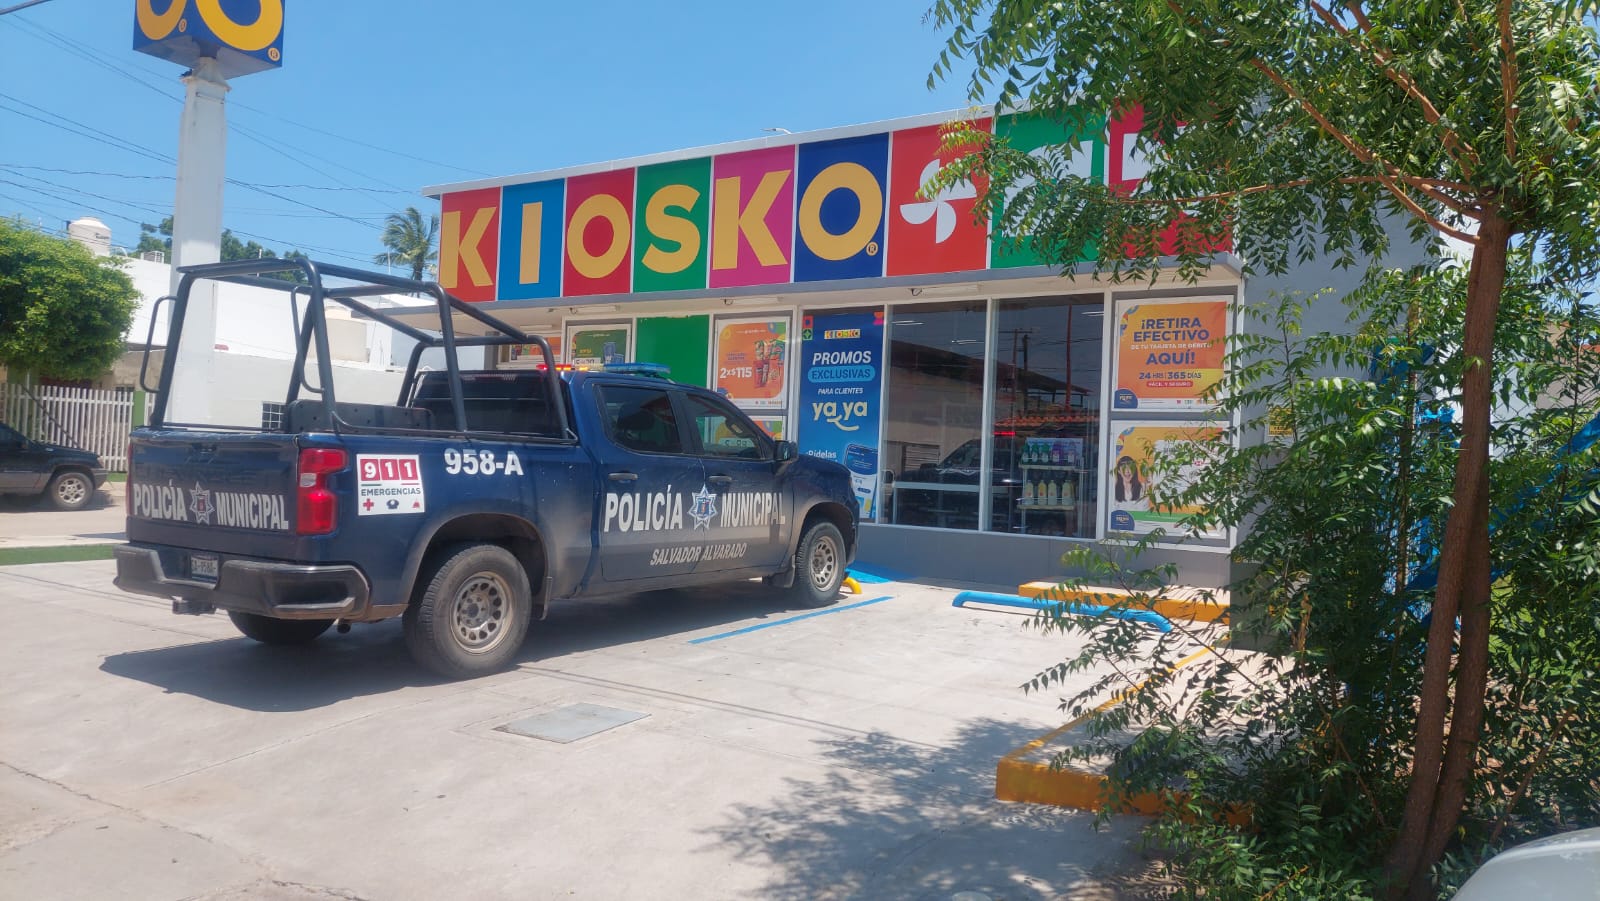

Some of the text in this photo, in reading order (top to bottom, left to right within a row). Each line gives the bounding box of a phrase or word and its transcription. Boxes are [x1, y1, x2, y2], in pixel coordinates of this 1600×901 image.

[438, 162, 882, 288] KIOSKO
[1141, 317, 1202, 330] ¡RETIRA
[1133, 329, 1210, 342] EFECTIVO
[812, 350, 872, 366] PROMOS
[1146, 348, 1196, 365] AQUÍ!
[811, 368, 871, 380] EXCLUSIVAS
[1167, 371, 1186, 379] 365
[834, 387, 864, 395] CLIENTES
[364, 461, 411, 479] 911
[444, 448, 524, 476] 958-A
[361, 487, 421, 497] EMERGENCIAS
[133, 478, 289, 530] POLICÍA MUNICIPAL
[603, 484, 786, 533] POLICÍA MUNICIPAL
[650, 542, 748, 566] SALVADOR ALVARADO
